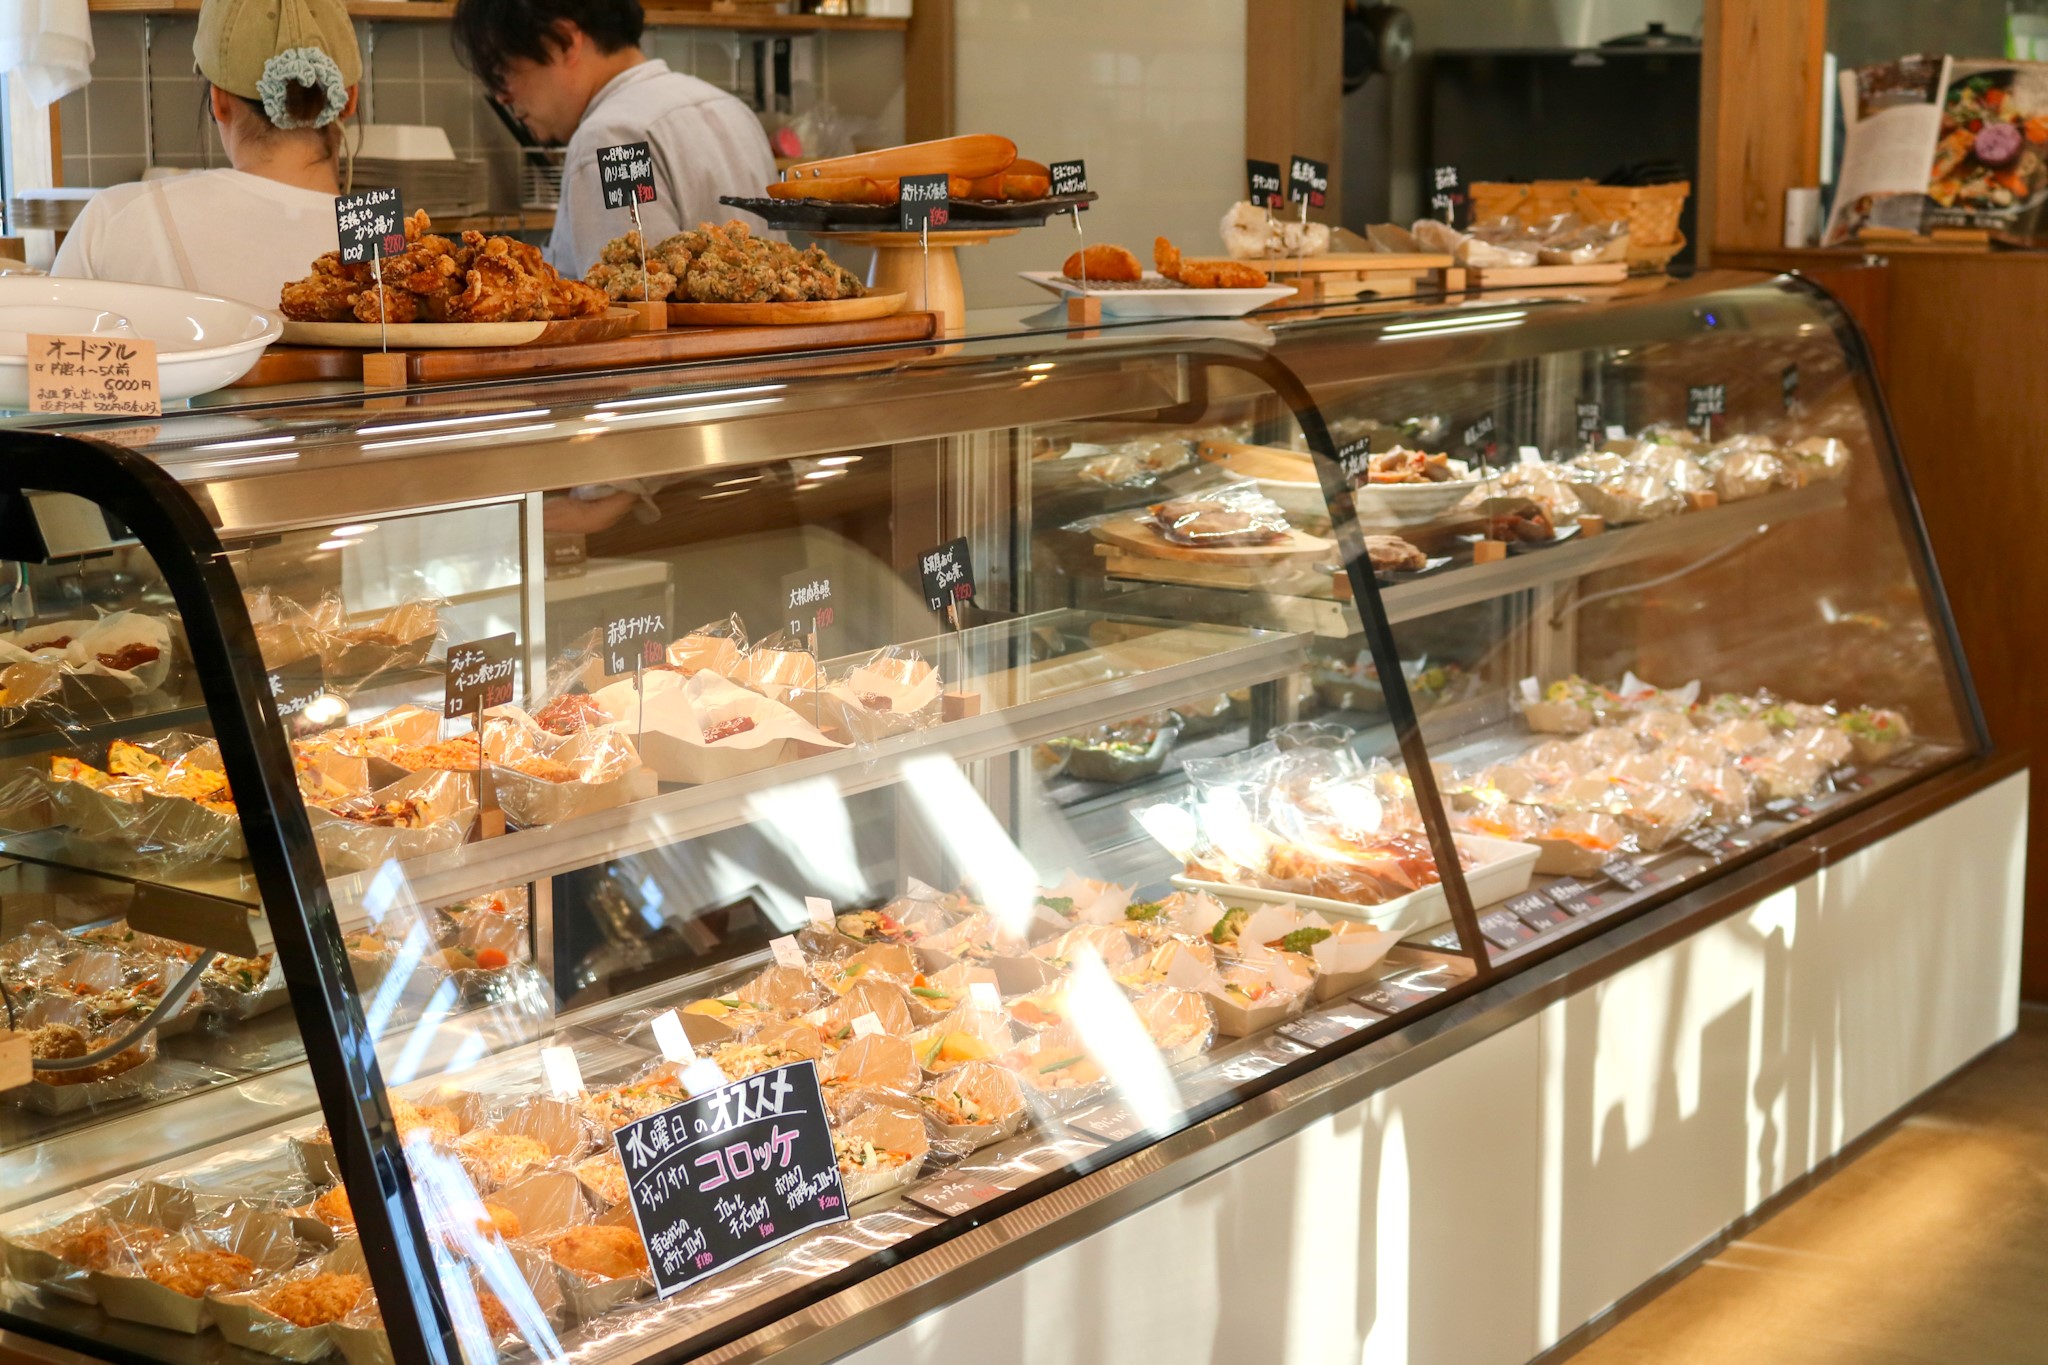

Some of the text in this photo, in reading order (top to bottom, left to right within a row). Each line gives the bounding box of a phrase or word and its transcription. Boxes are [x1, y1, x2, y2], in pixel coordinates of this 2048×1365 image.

[354, 210, 396, 241] から揚げ
[343, 243, 364, 261] 100g
[383, 234, 405, 256] ¥280
[46, 339, 138, 362] オードブル
[935, 561, 964, 590] 含め煮
[607, 614, 666, 648] 赤魚チリソース
[450, 650, 486, 674] ズッキーニ
[455, 657, 514, 693] ベーコン巻きフライ
[449, 697, 463, 714] 1コ
[486, 682, 513, 709] ¥200
[625, 1068, 795, 1170] 水曜日のオススメ
[694, 1124, 800, 1193] コロッケ
[774, 1164, 804, 1196] ホクホク
[786, 1164, 840, 1212] かぼちゃコロッケ
[922, 1182, 975, 1205] チャプチェ
[713, 1193, 745, 1223] ゴロッと
[728, 1196, 771, 1240] チーズコロッケ
[817, 1195, 840, 1212] ¥200
[758, 1221, 775, 1239] ¥200
[662, 1226, 708, 1277] ポテトコロッケ
[694, 1251, 714, 1270] ¥180
